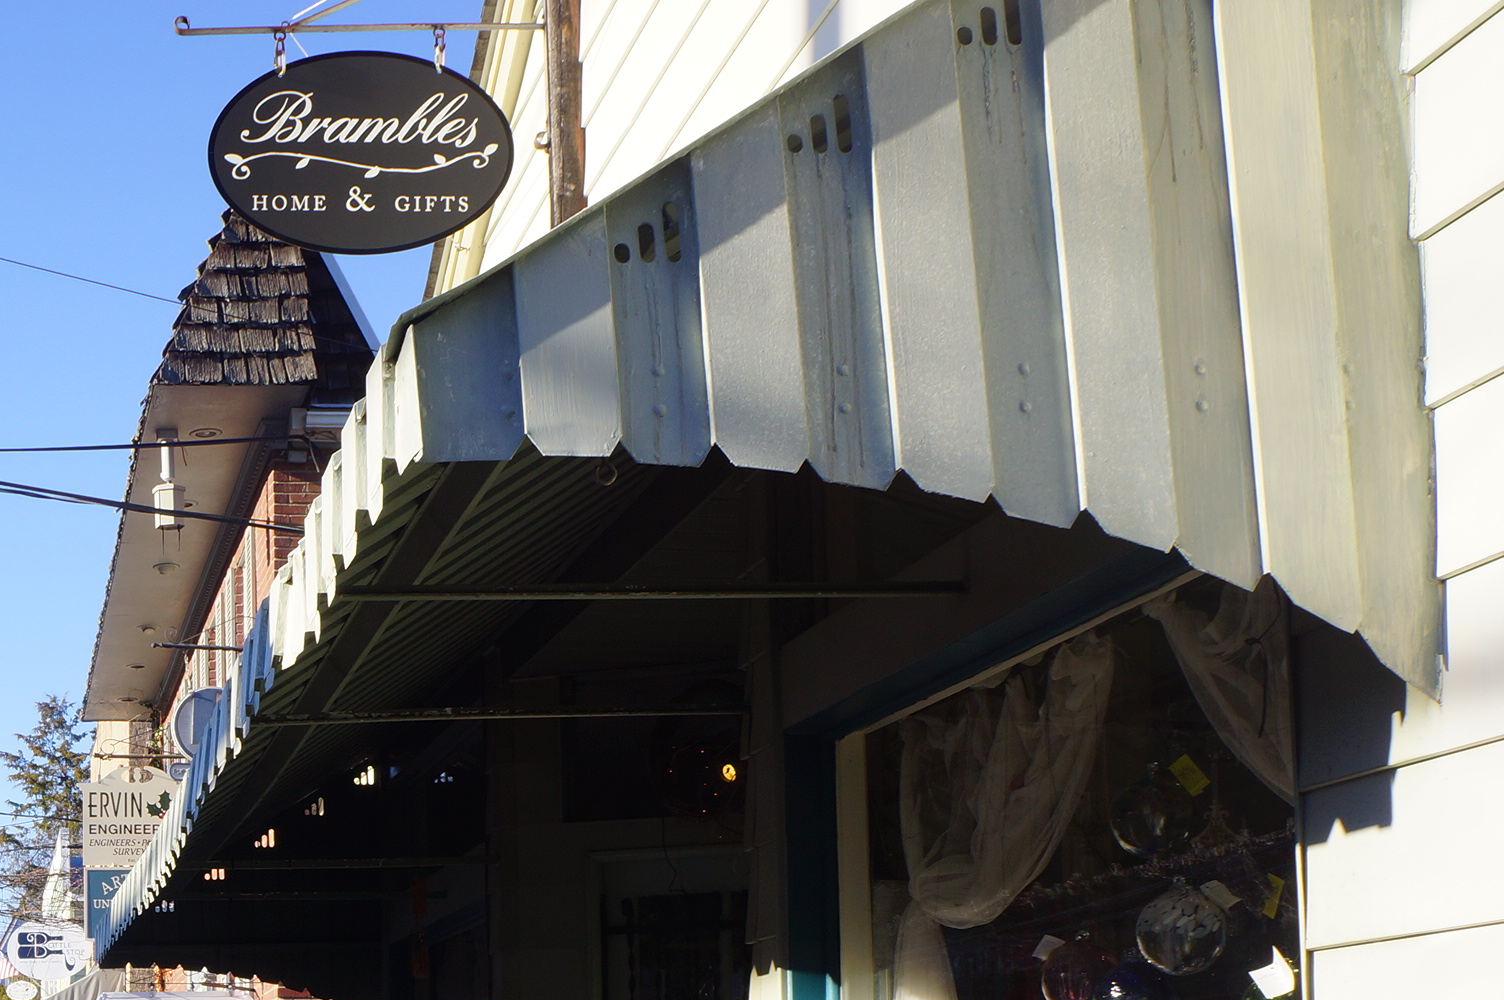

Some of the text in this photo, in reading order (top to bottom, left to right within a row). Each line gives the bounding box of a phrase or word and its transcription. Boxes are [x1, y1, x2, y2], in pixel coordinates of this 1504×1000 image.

[240, 90, 479, 148] Brambles
[251, 186, 470, 213] HOME & GIFTS
[88, 792, 143, 818] ERVIN
[88, 838, 136, 847] ENGINEERS
